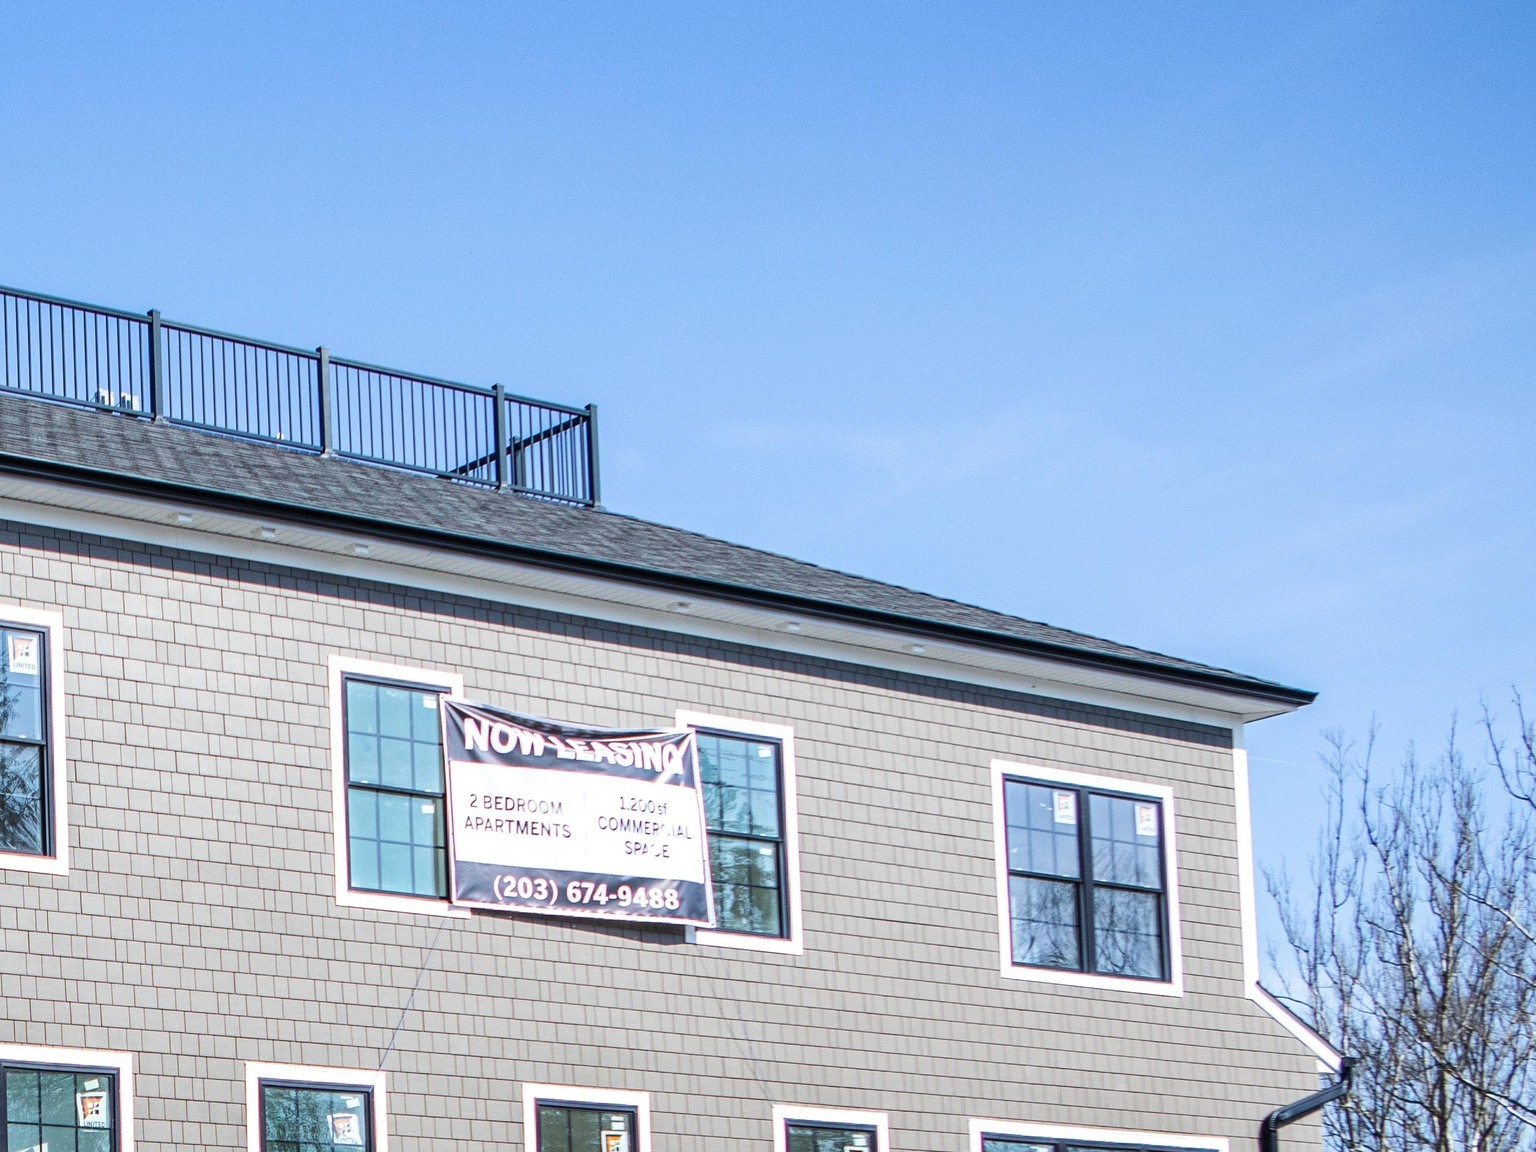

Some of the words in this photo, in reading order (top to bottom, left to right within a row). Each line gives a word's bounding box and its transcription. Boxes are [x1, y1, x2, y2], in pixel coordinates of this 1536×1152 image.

[13, 662, 36, 671] UNITED
[464, 718, 545, 757] NOW
[549, 736, 684, 775] LEASING
[469, 793, 478, 808] 2
[483, 795, 563, 815] BEDROOM
[464, 815, 571, 839] APARTMENTS
[493, 875, 559, 906] (203)
[566, 881, 680, 910] 674-9488
